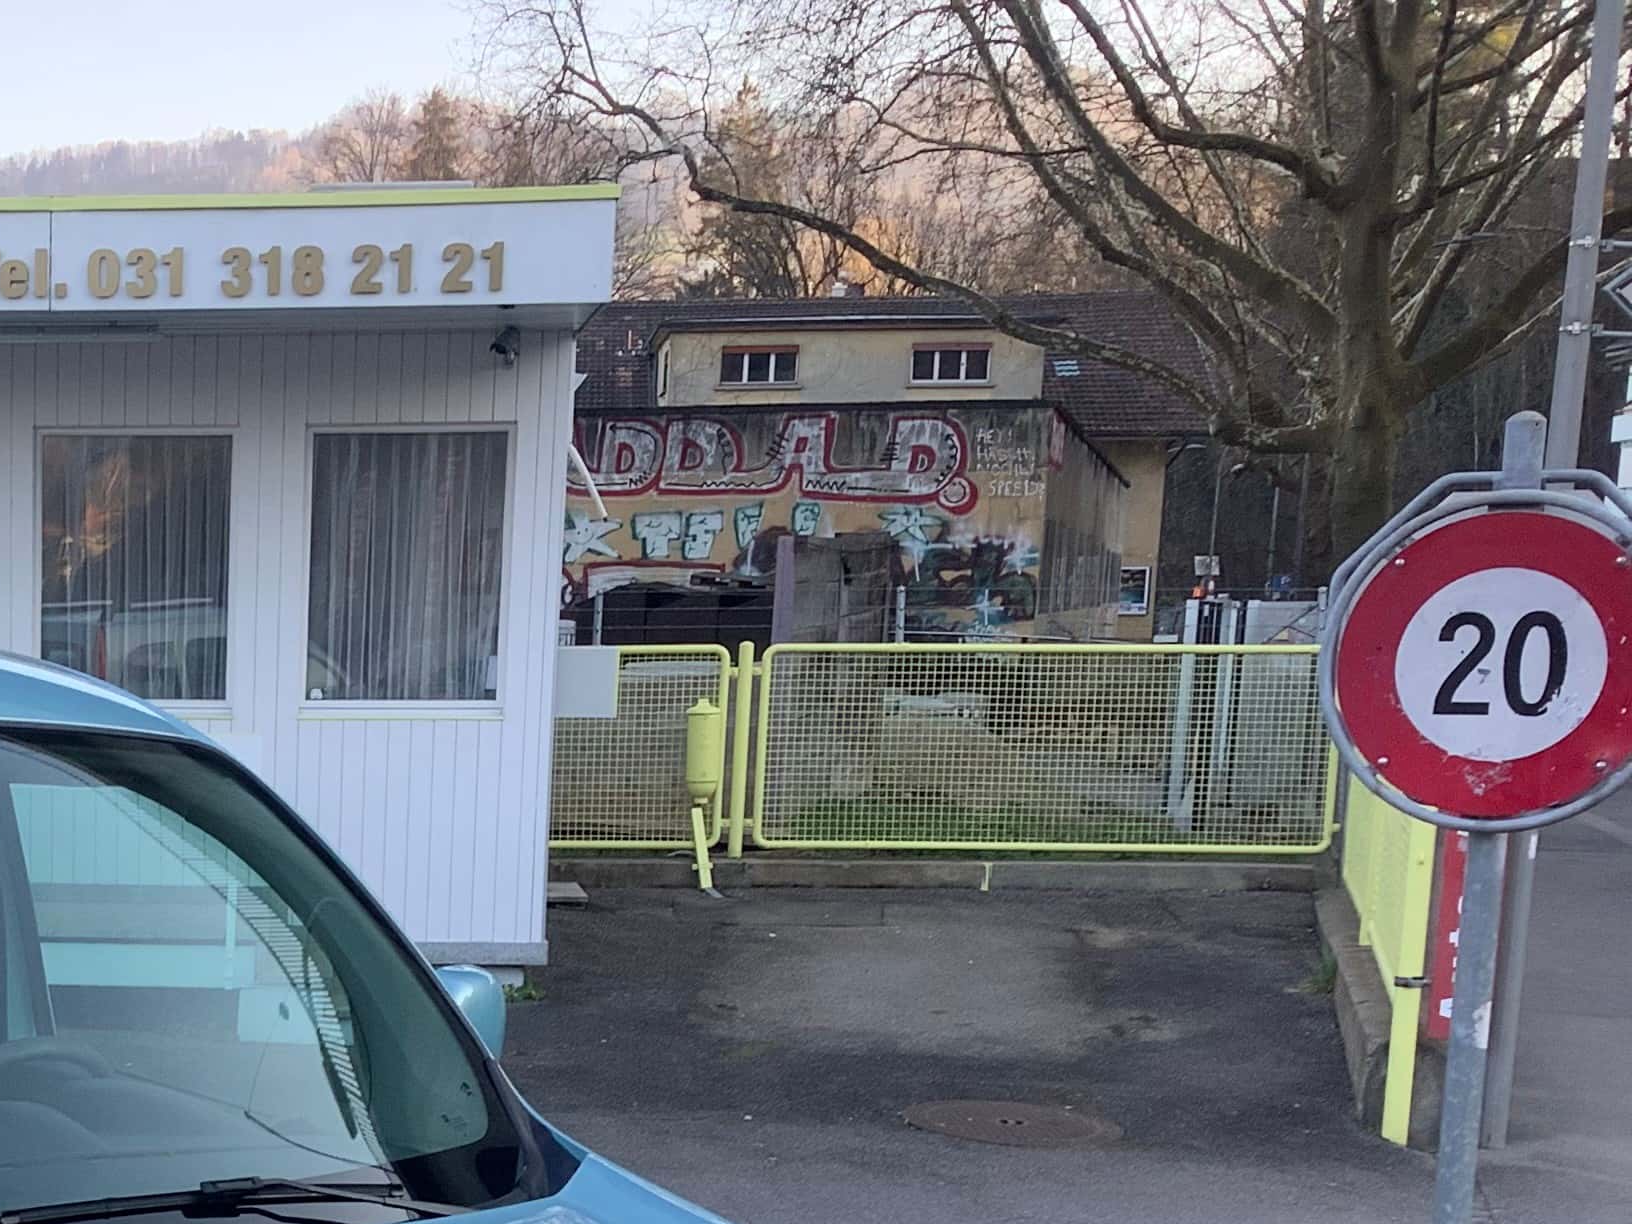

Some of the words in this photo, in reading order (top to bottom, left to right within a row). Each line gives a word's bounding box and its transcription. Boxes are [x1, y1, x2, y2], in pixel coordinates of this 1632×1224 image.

[86, 247, 185, 298] 031
[220, 245, 325, 298] 318
[351, 243, 414, 295] 21
[440, 241, 506, 294] 21
[1432, 610, 1568, 717] 20
